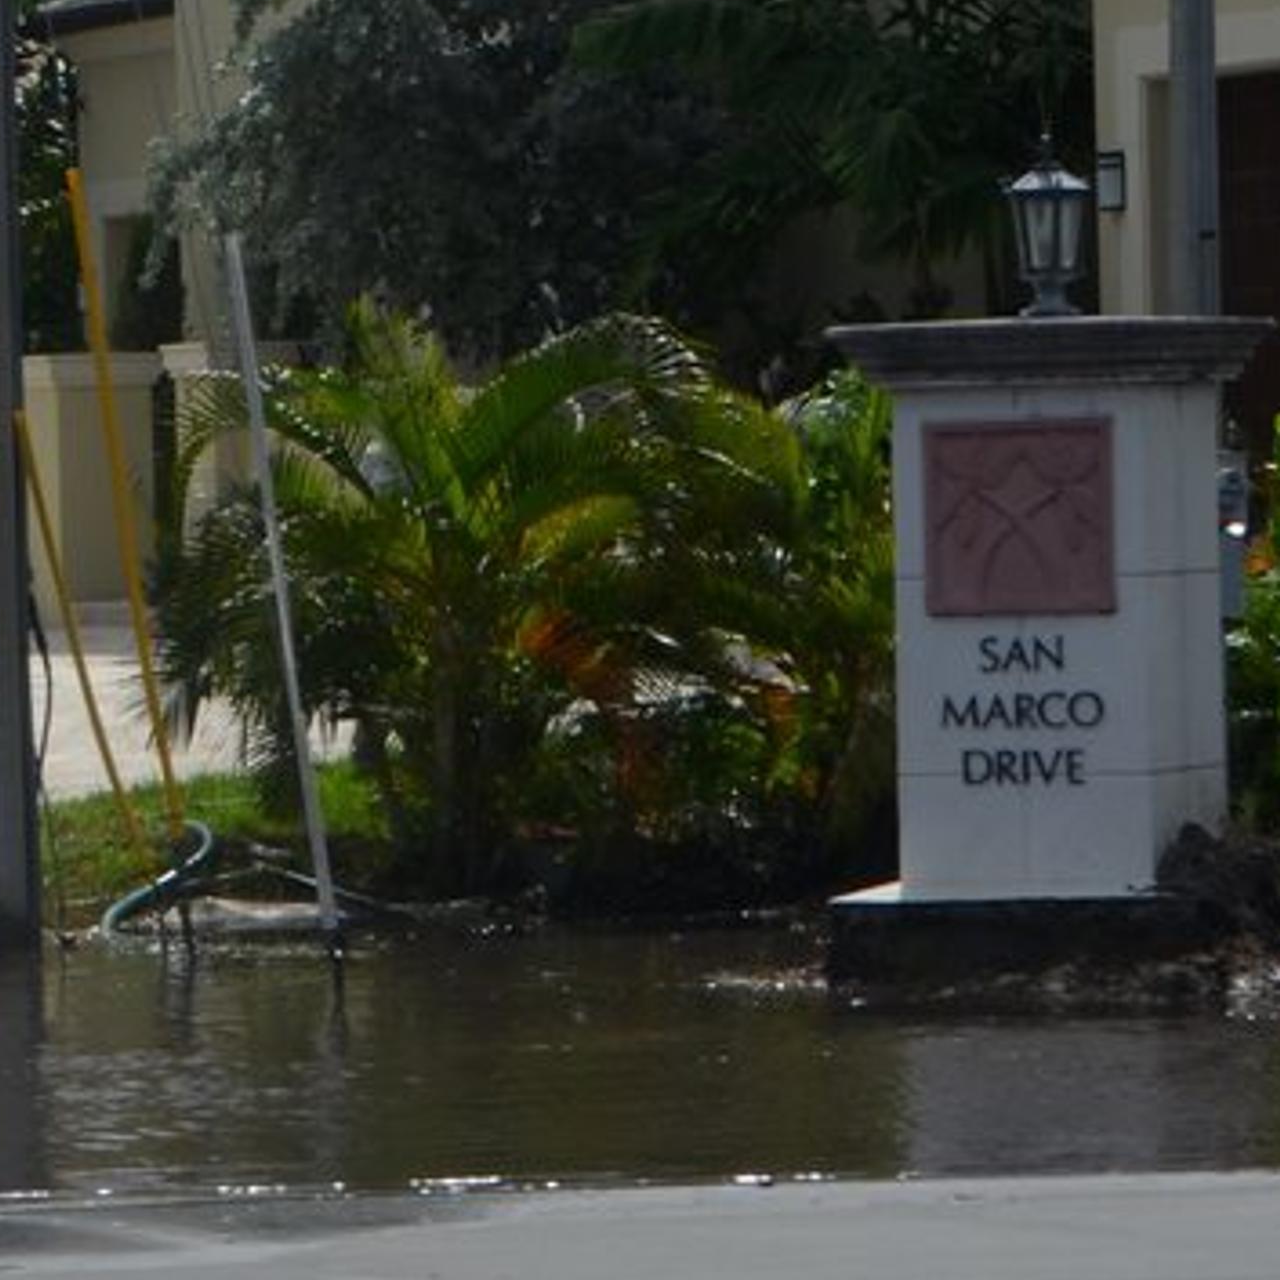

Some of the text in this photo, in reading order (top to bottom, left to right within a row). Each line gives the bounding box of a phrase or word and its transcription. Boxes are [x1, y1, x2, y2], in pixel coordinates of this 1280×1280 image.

[979, 636, 1065, 673] SAN
[941, 691, 1105, 730] MARCO
[962, 749, 1086, 786] DRIVE
